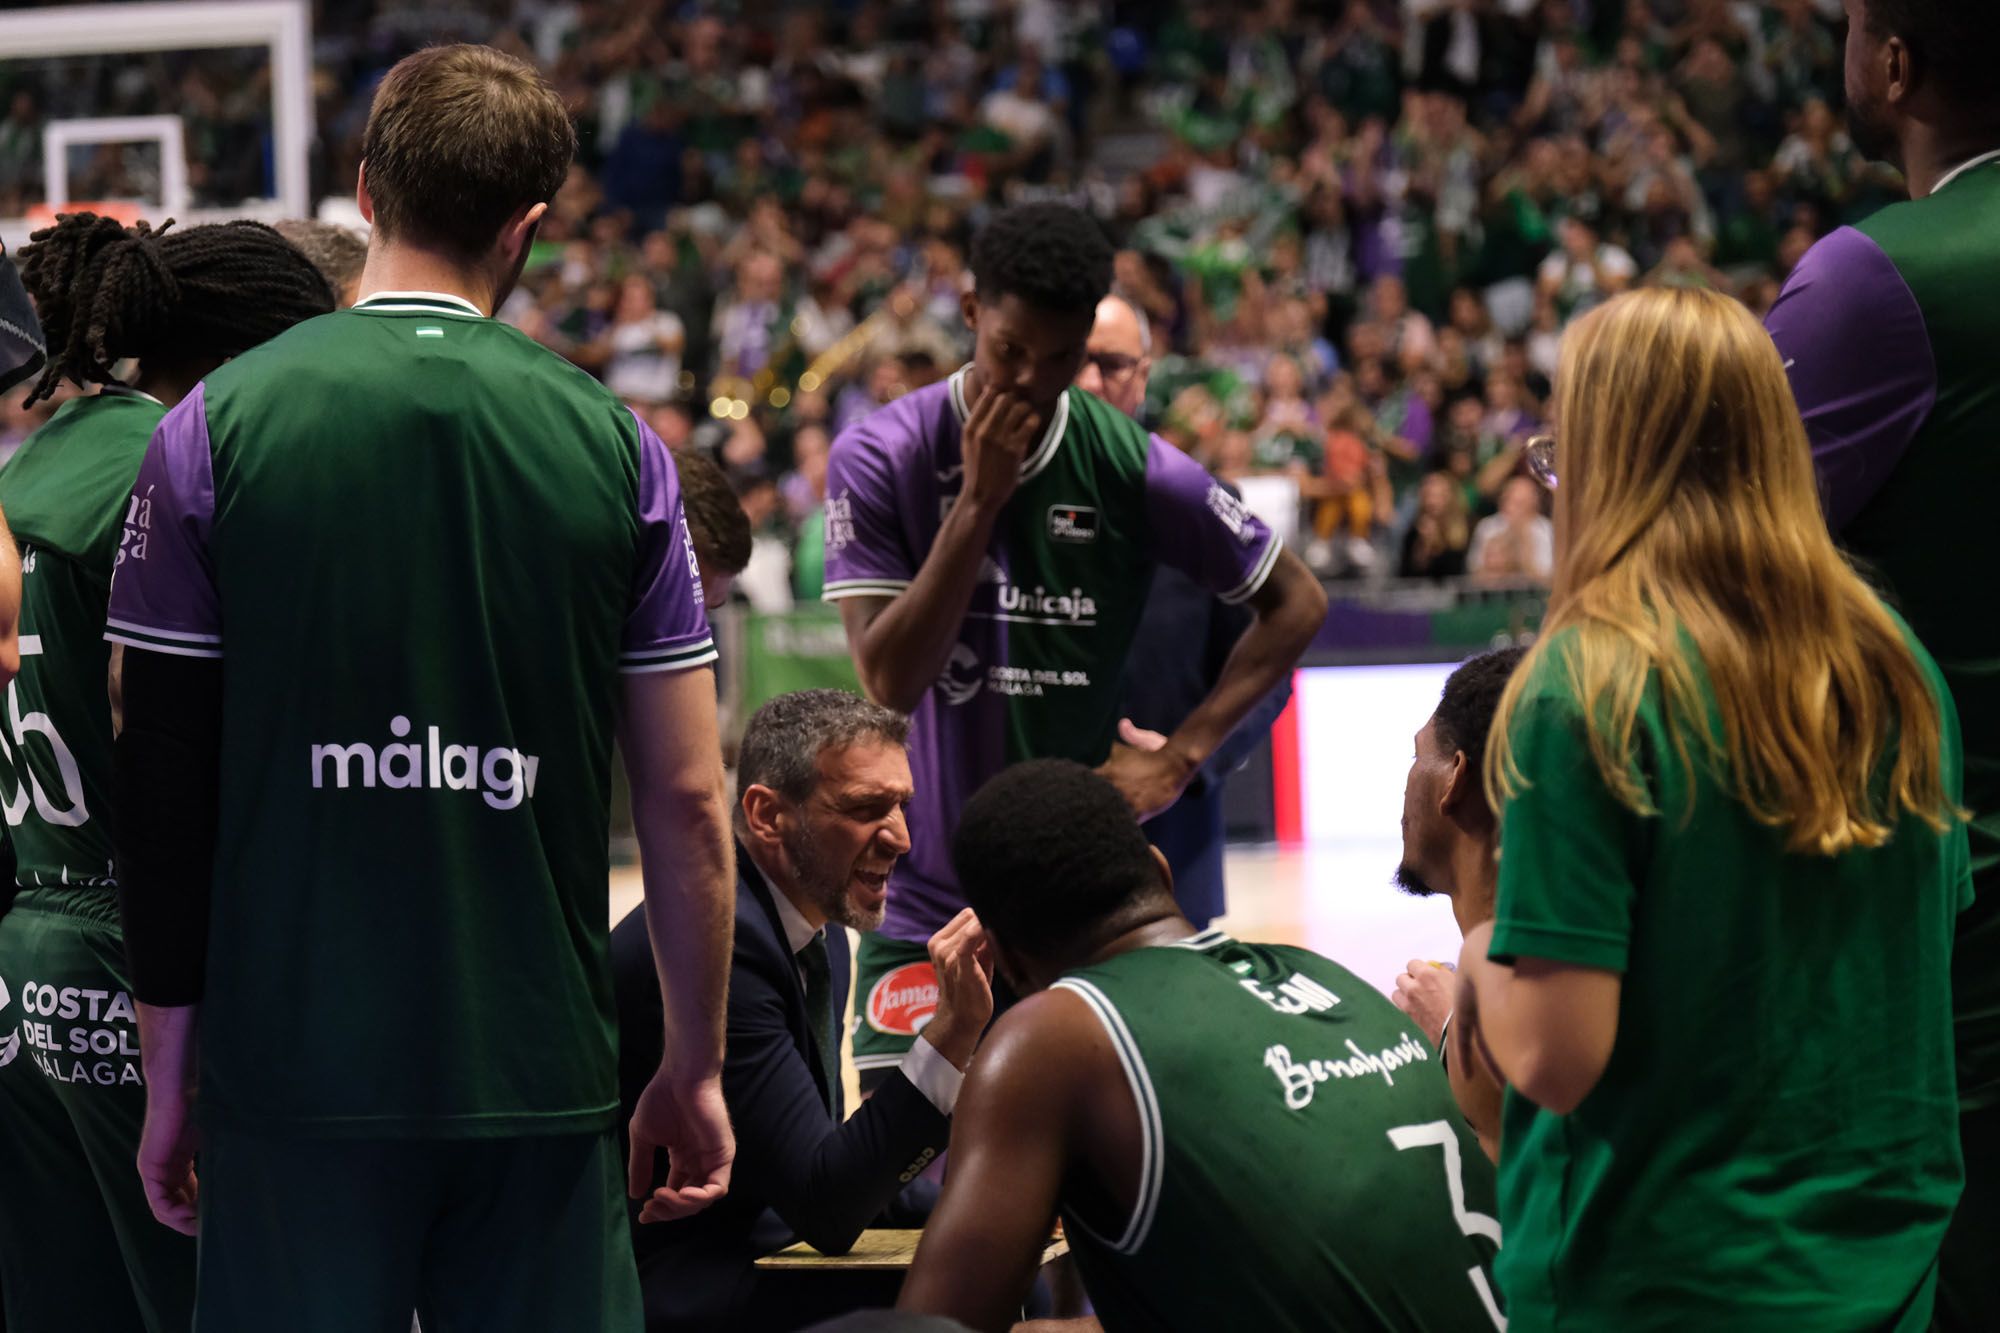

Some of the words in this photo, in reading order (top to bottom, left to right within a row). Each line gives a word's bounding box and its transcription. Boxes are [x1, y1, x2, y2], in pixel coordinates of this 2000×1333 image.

[998, 585, 1097, 622] Unicaja
[1061, 671, 1091, 686] SOL
[22, 980, 137, 1024] COSTA
[22, 1019, 62, 1052] DEL
[69, 1027, 140, 1057] SOL
